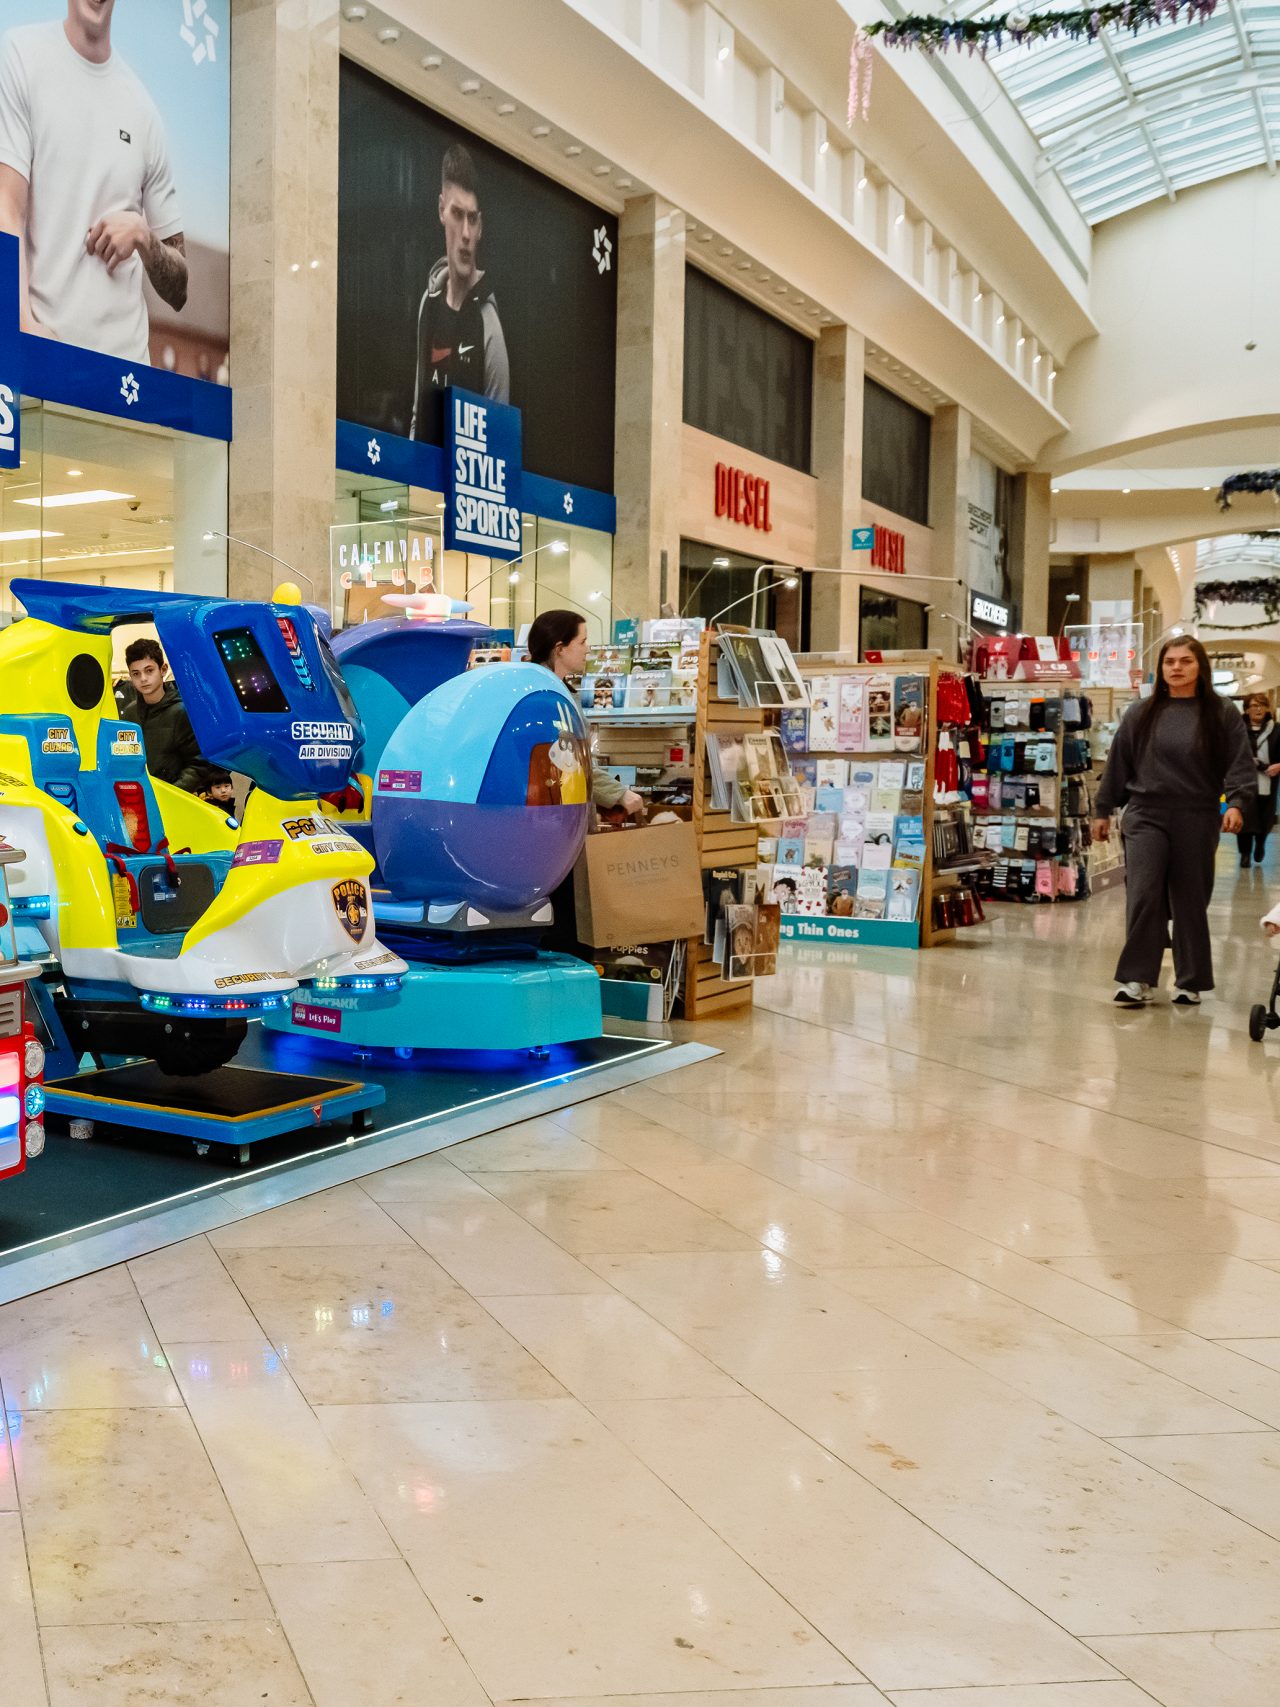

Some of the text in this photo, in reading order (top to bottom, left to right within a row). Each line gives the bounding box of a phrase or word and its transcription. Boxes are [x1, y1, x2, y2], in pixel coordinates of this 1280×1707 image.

[455, 398, 487, 442] LIFE
[455, 447, 506, 493] STYLE
[714, 462, 773, 532] DIESEL
[455, 494, 519, 542] SPORTS
[339, 537, 433, 567] CALENDAR
[340, 567, 433, 589] CLUB
[48, 729, 68, 739] CITY
[118, 731, 136, 741] CITY
[293, 723, 352, 740] SECURITY
[300, 747, 351, 758] AIR DIVISION
[607, 856, 680, 876] PENNEYS
[333, 883, 364, 901] POLICE
[780, 922, 859, 938] ng Thin Ones
[610, 945, 649, 955] Puppies
[215, 971, 273, 989] SECURITY
[308, 1013, 322, 1024] Let's
